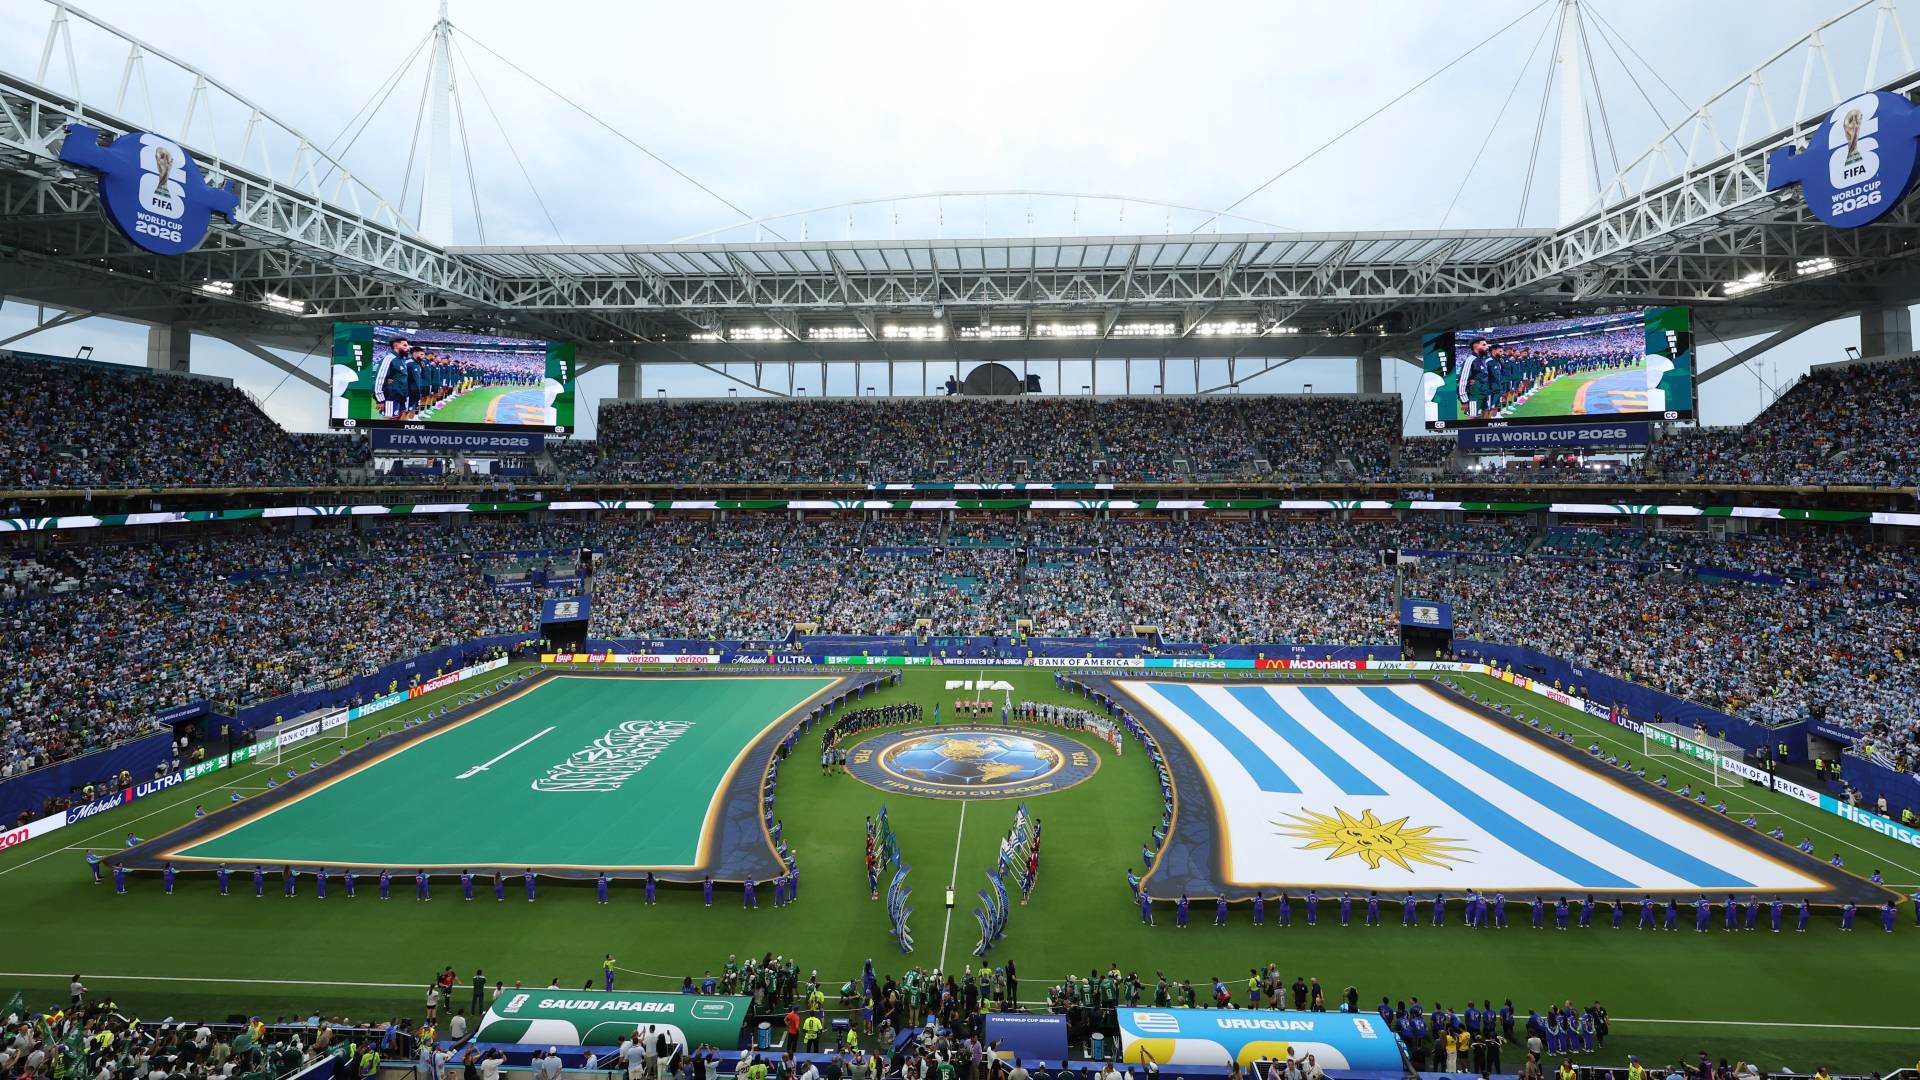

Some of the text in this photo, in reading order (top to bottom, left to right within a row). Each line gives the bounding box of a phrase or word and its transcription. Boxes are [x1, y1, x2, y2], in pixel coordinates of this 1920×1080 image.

[1844, 165, 1866, 179] FIFA
[1832, 181, 1881, 203] WORLD CUP
[152, 198, 172, 211] FIFA
[1832, 191, 1882, 216] 2026
[137, 212, 182, 230] WORLD CUP
[136, 220, 182, 243] 2026
[1664, 410, 1678, 418] CC
[390, 435, 529, 446] FIFA WORLD CUP 2026
[1475, 428, 1627, 442] FIFA WORLD CUP 2026
[732, 656, 812, 664] Michelob ULTRA
[1039, 658, 1129, 666] BANK OF AMERICA
[1173, 660, 1225, 668] Hisense
[1289, 660, 1356, 669] McDonald's
[423, 674, 458, 693] McDonald's
[945, 680, 1014, 690] FIFA
[1546, 689, 1570, 705] verizon
[358, 695, 401, 717] Hisense
[1585, 702, 1644, 736] Michelob ULTRA
[300, 729, 308, 737] OF
[1725, 760, 1805, 798] BANK OF AERICA
[882, 780, 909, 790] FIFA
[912, 786, 966, 796] WORLD
[1004, 782, 1053, 794] 2026
[68, 773, 182, 824] Michelob ULTRA
[1838, 801, 1920, 848] Hisense
[0, 828, 29, 850] zon
[538, 999, 675, 1013] SAUDI ARABIA
[1216, 1018, 1314, 1031] URUGUAY
